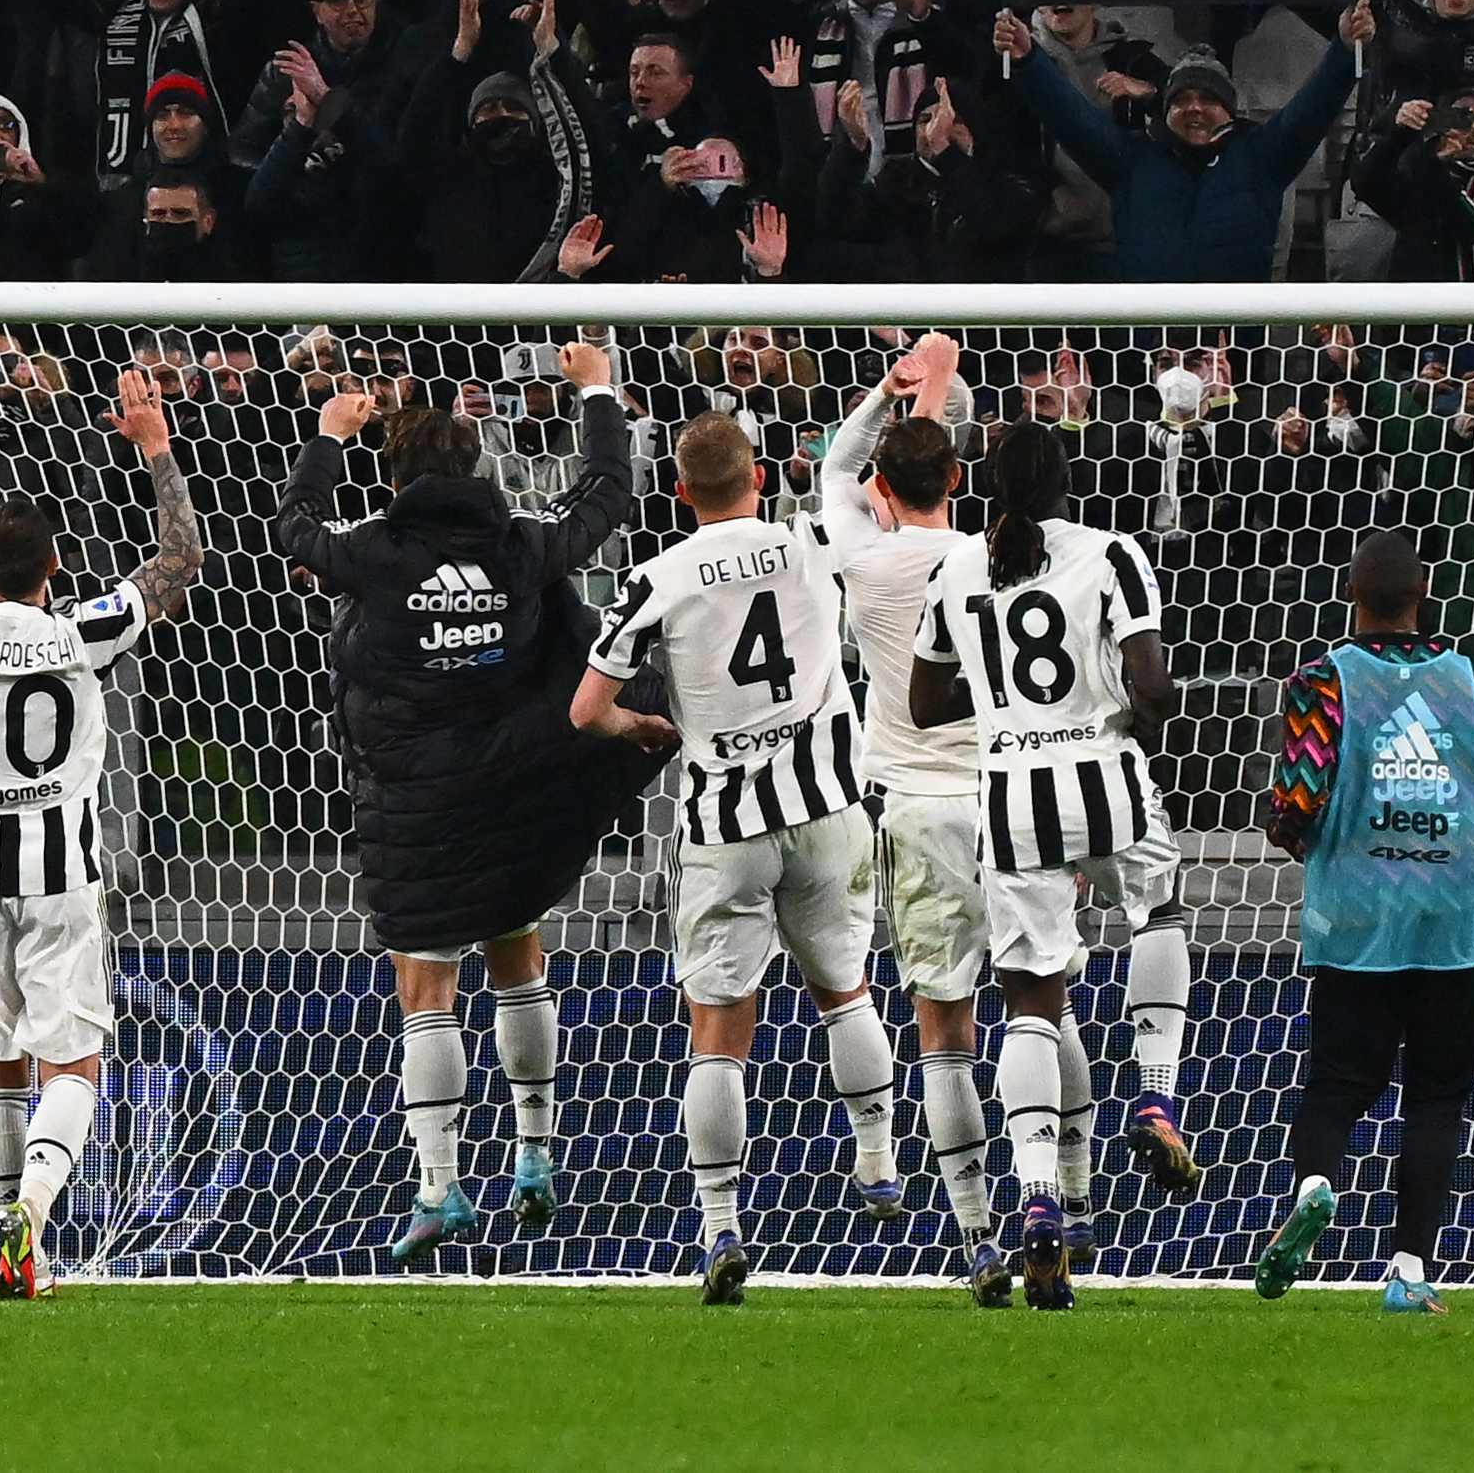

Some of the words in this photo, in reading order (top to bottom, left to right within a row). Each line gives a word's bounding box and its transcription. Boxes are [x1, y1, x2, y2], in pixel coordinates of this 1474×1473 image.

[699, 558, 732, 587] DE
[736, 544, 789, 579] LIGT
[407, 589, 509, 614] adidas
[419, 621, 504, 651] Jeep
[727, 589, 797, 705] 4
[965, 589, 1076, 710] 18
[997, 725, 1097, 752] Cygames
[1371, 758, 1451, 783] adidas
[1369, 801, 1449, 842] Jeep
